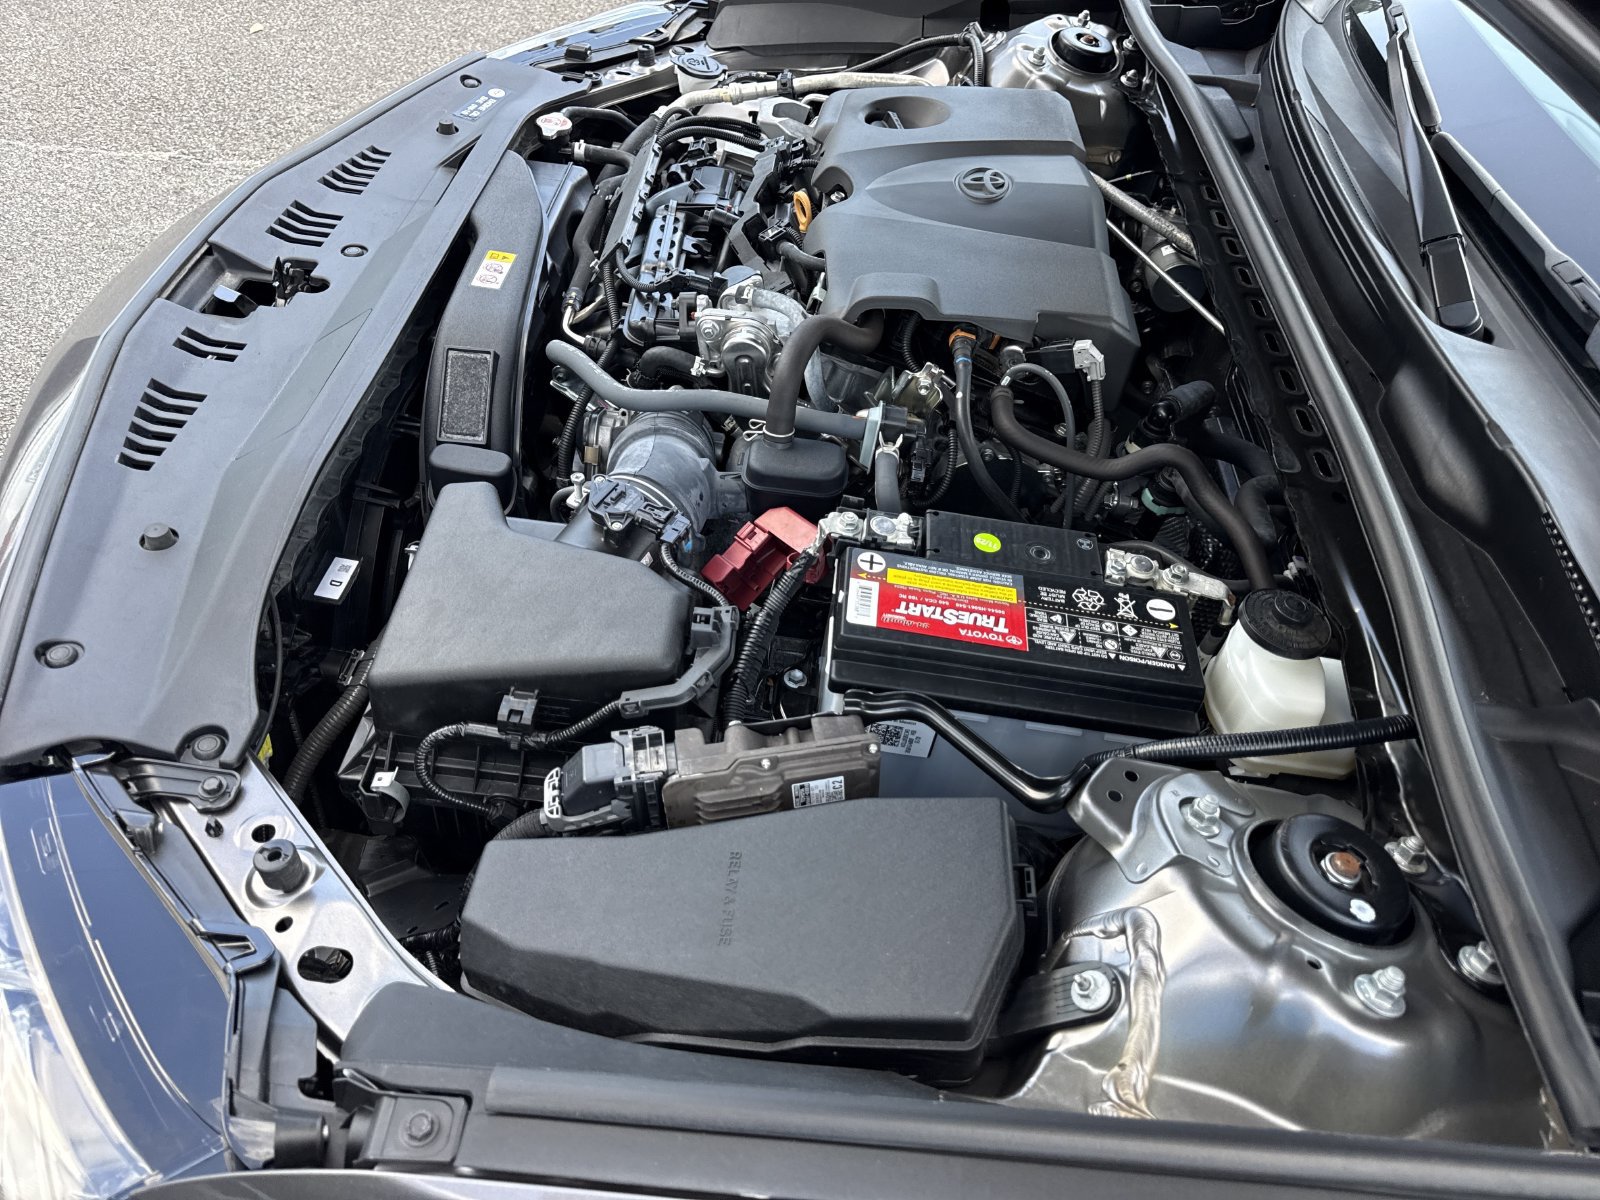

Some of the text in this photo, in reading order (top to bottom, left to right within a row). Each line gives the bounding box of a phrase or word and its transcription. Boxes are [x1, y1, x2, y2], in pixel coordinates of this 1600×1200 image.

[1037, 585, 1066, 594] RECYCLED
[1040, 595, 1065, 603] BATTERY
[958, 627, 1004, 641] TOYOTA
[1118, 654, 1174, 669] DANGER/POISON
[831, 779, 842, 789] C2
[717, 851, 742, 945] RELAY & FUSE
